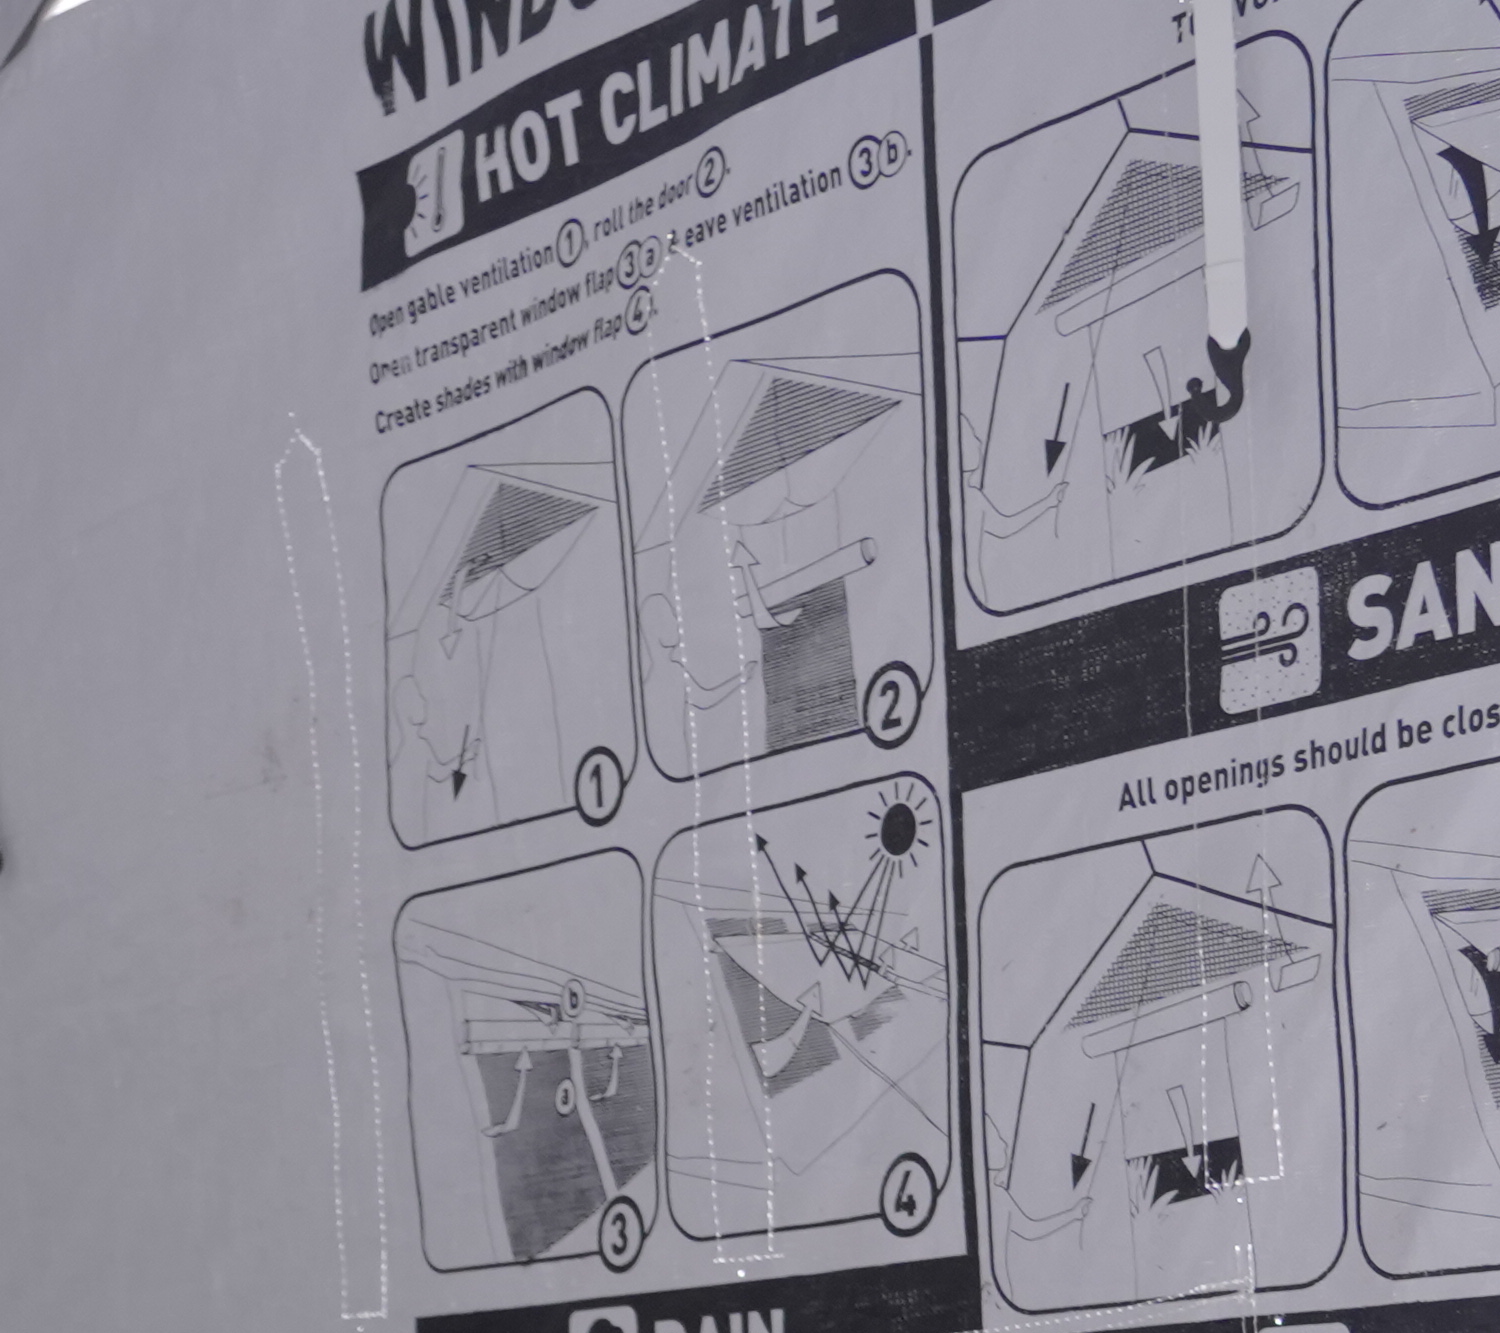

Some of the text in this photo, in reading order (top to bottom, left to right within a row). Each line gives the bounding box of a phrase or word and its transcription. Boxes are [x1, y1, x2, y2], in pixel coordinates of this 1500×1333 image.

[475, 0, 840, 203] HOT CLIMATE
[369, 306, 405, 338] Open
[408, 283, 456, 325] gable
[460, 243, 554, 297] ventilation
[594, 215, 624, 242] roll
[629, 196, 654, 223] the
[658, 172, 694, 210] door
[414, 307, 518, 368] transparent
[520, 282, 582, 327] window
[585, 266, 615, 298] flap
[685, 213, 728, 248] eave
[733, 165, 843, 223] ventilation
[375, 398, 432, 434] Create
[437, 373, 492, 414] shades
[495, 354, 528, 389] with
[532, 329, 592, 372] window
[594, 312, 623, 345] flap
[1118, 778, 1158, 812] All
[1165, 754, 1285, 805] openings
[1294, 722, 1388, 773] should
[1396, 717, 1433, 750] be
